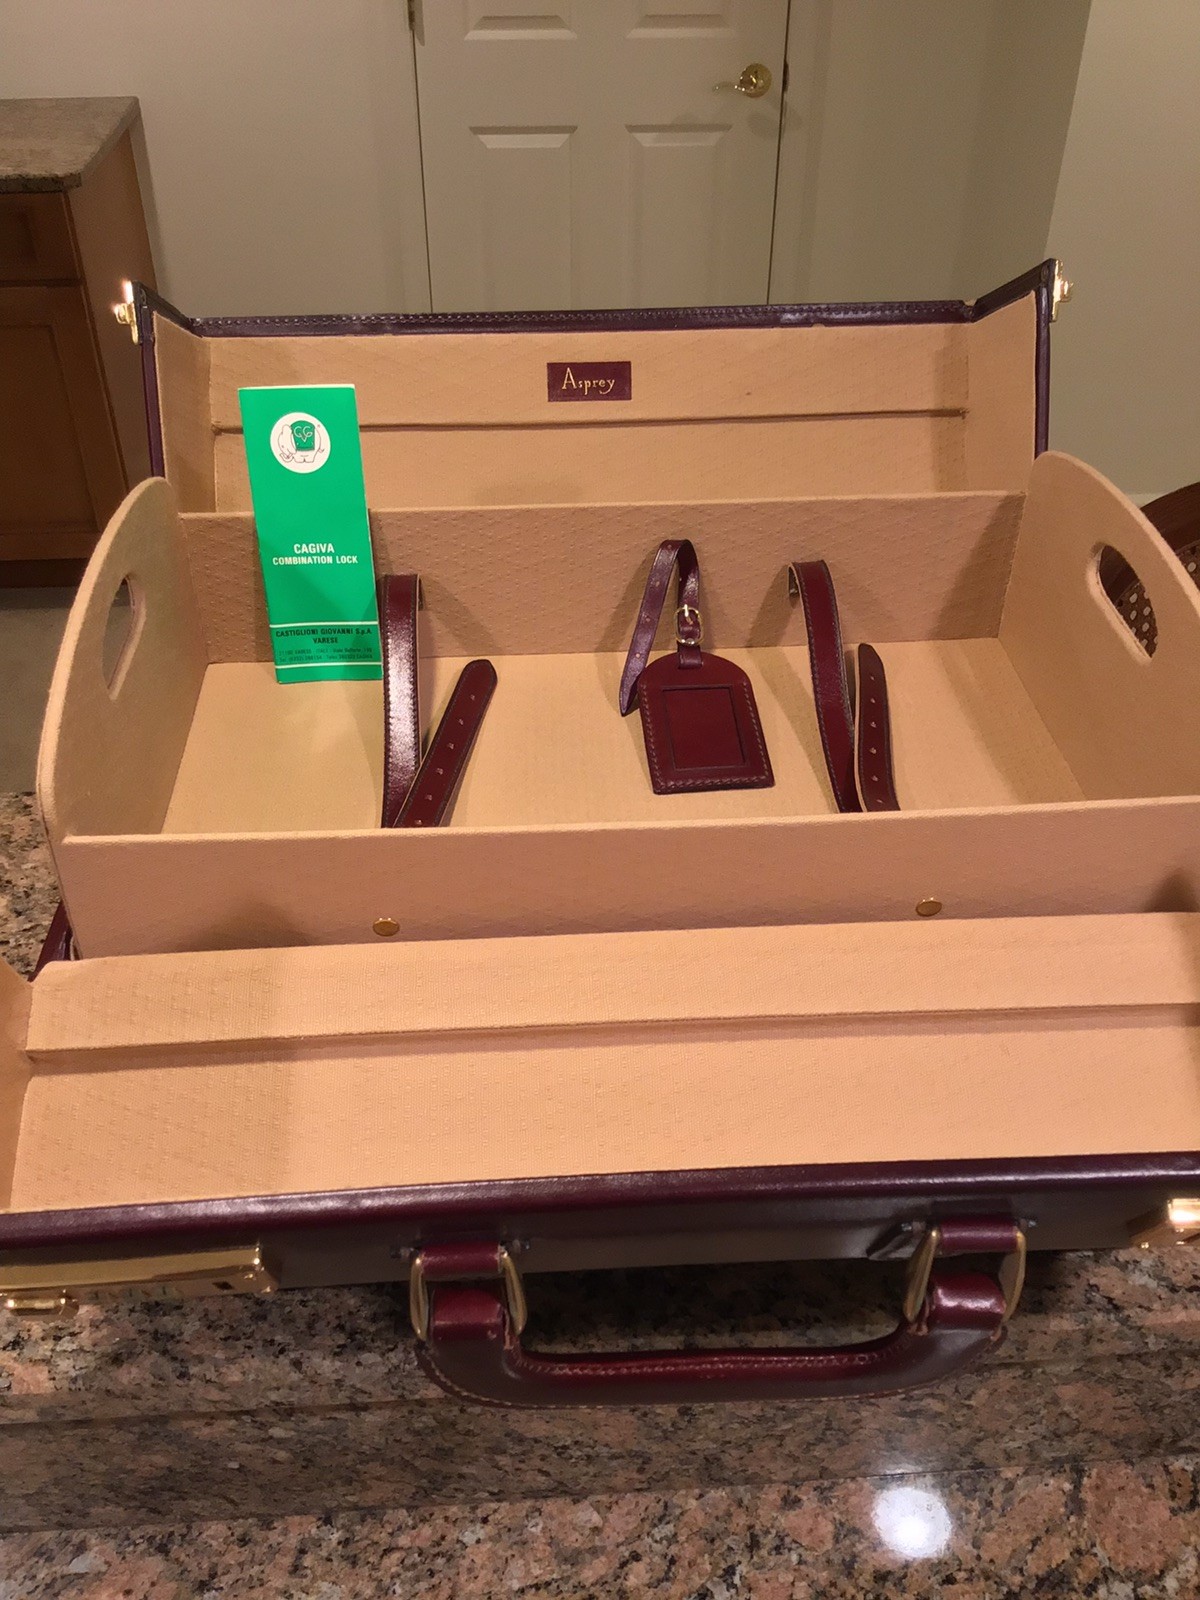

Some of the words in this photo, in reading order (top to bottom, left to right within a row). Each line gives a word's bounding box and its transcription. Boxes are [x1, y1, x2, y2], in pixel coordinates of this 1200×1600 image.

[561, 367, 615, 395] Asprey
[293, 543, 335, 554] CAGIVA
[272, 556, 333, 565] COMBINATION
[336, 555, 358, 564] LOCK
[276, 629, 318, 637] CASTIGLIONI
